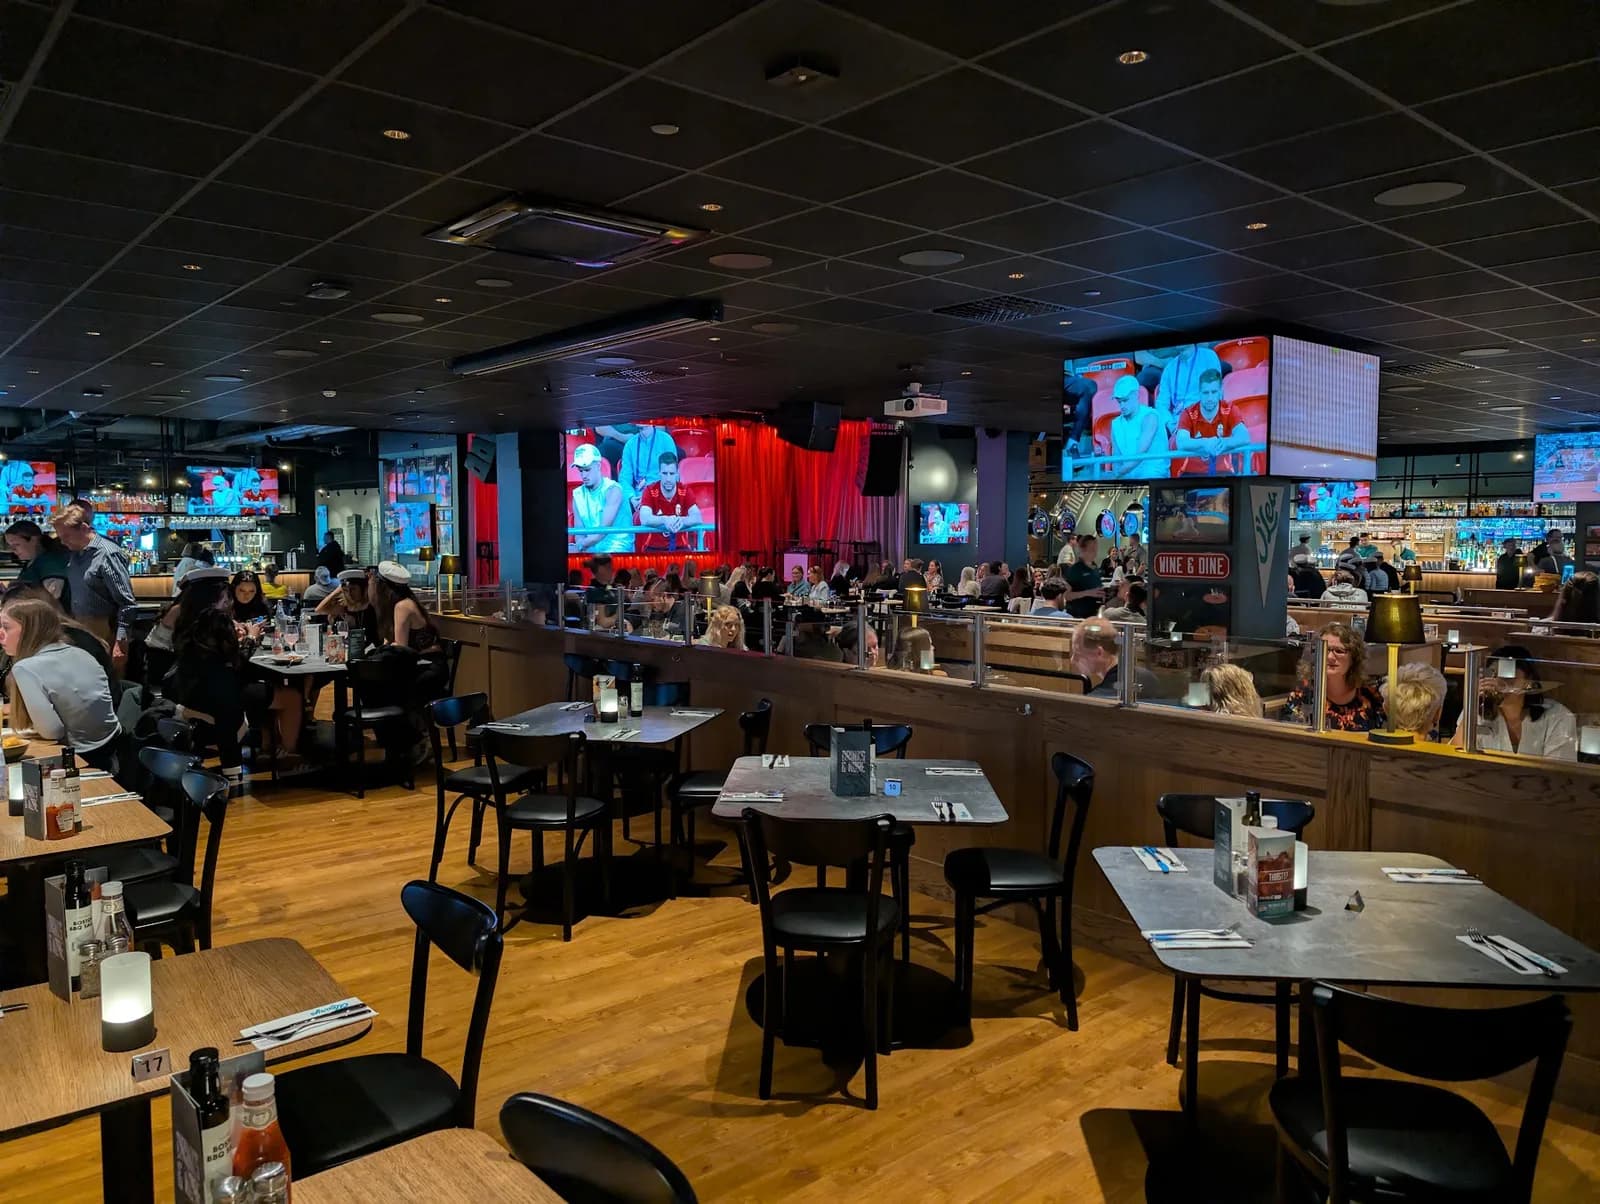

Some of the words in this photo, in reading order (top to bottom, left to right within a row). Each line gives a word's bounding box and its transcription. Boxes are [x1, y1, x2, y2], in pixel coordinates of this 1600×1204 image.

[1159, 556, 1184, 574] WINE
[1187, 557, 1195, 574] &
[1198, 557, 1225, 575] DINE
[142, 1055, 163, 1073] 17
[207, 1150, 225, 1162] BBQ
